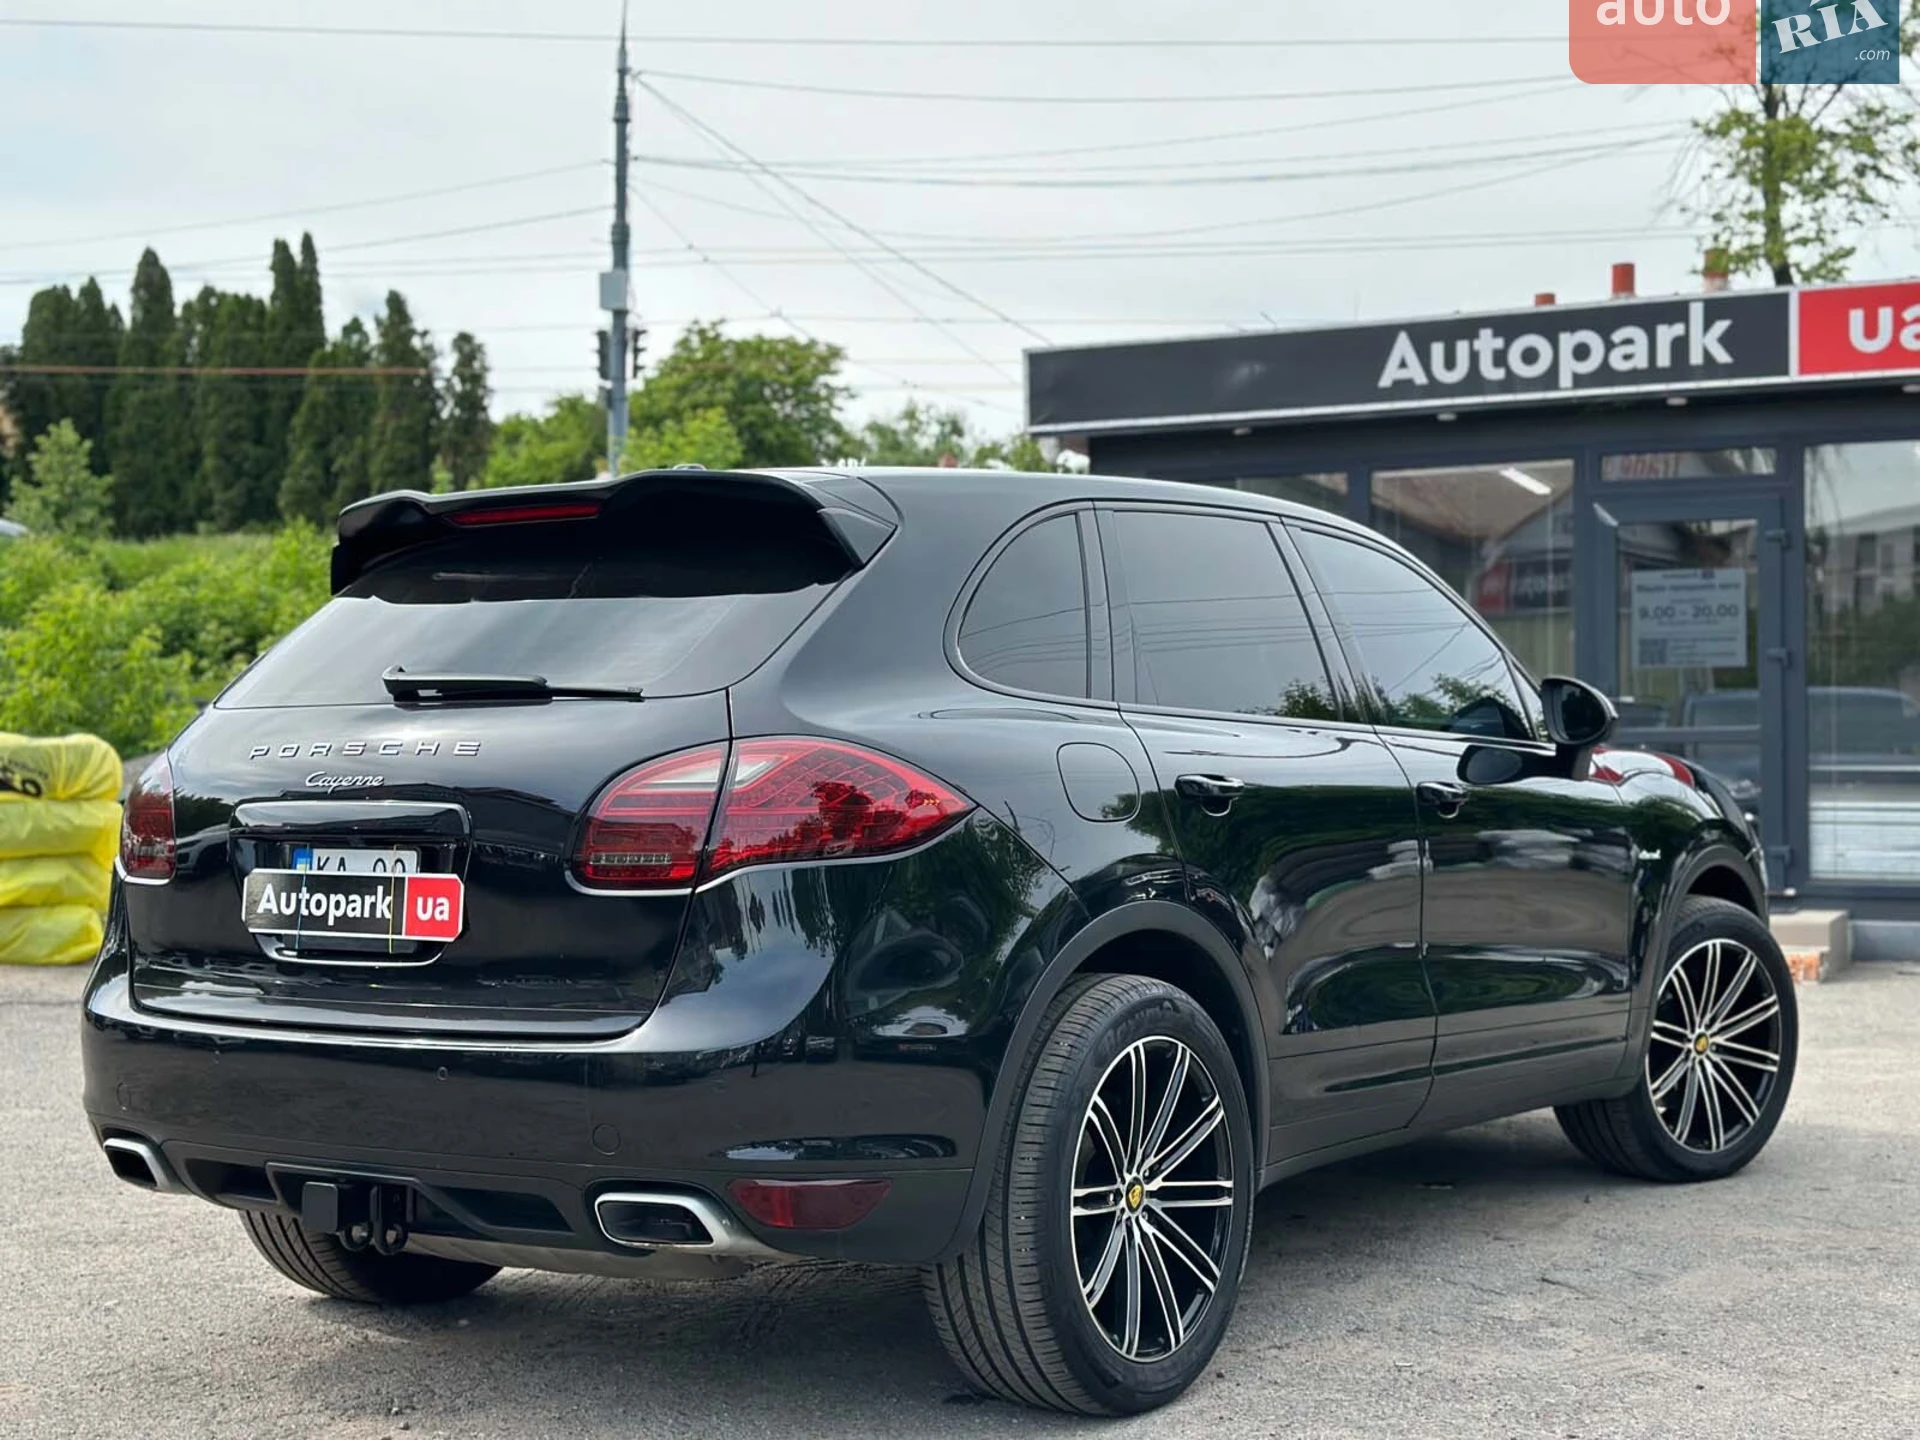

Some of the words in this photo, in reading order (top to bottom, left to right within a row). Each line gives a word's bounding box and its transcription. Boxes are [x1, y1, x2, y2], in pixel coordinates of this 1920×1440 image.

[1377, 302, 1734, 389] Autopark
[249, 740, 482, 760] PORSCHE
[305, 771, 384, 794] Cayenne
[256, 882, 393, 926] Autopark
[416, 896, 450, 921] ua
